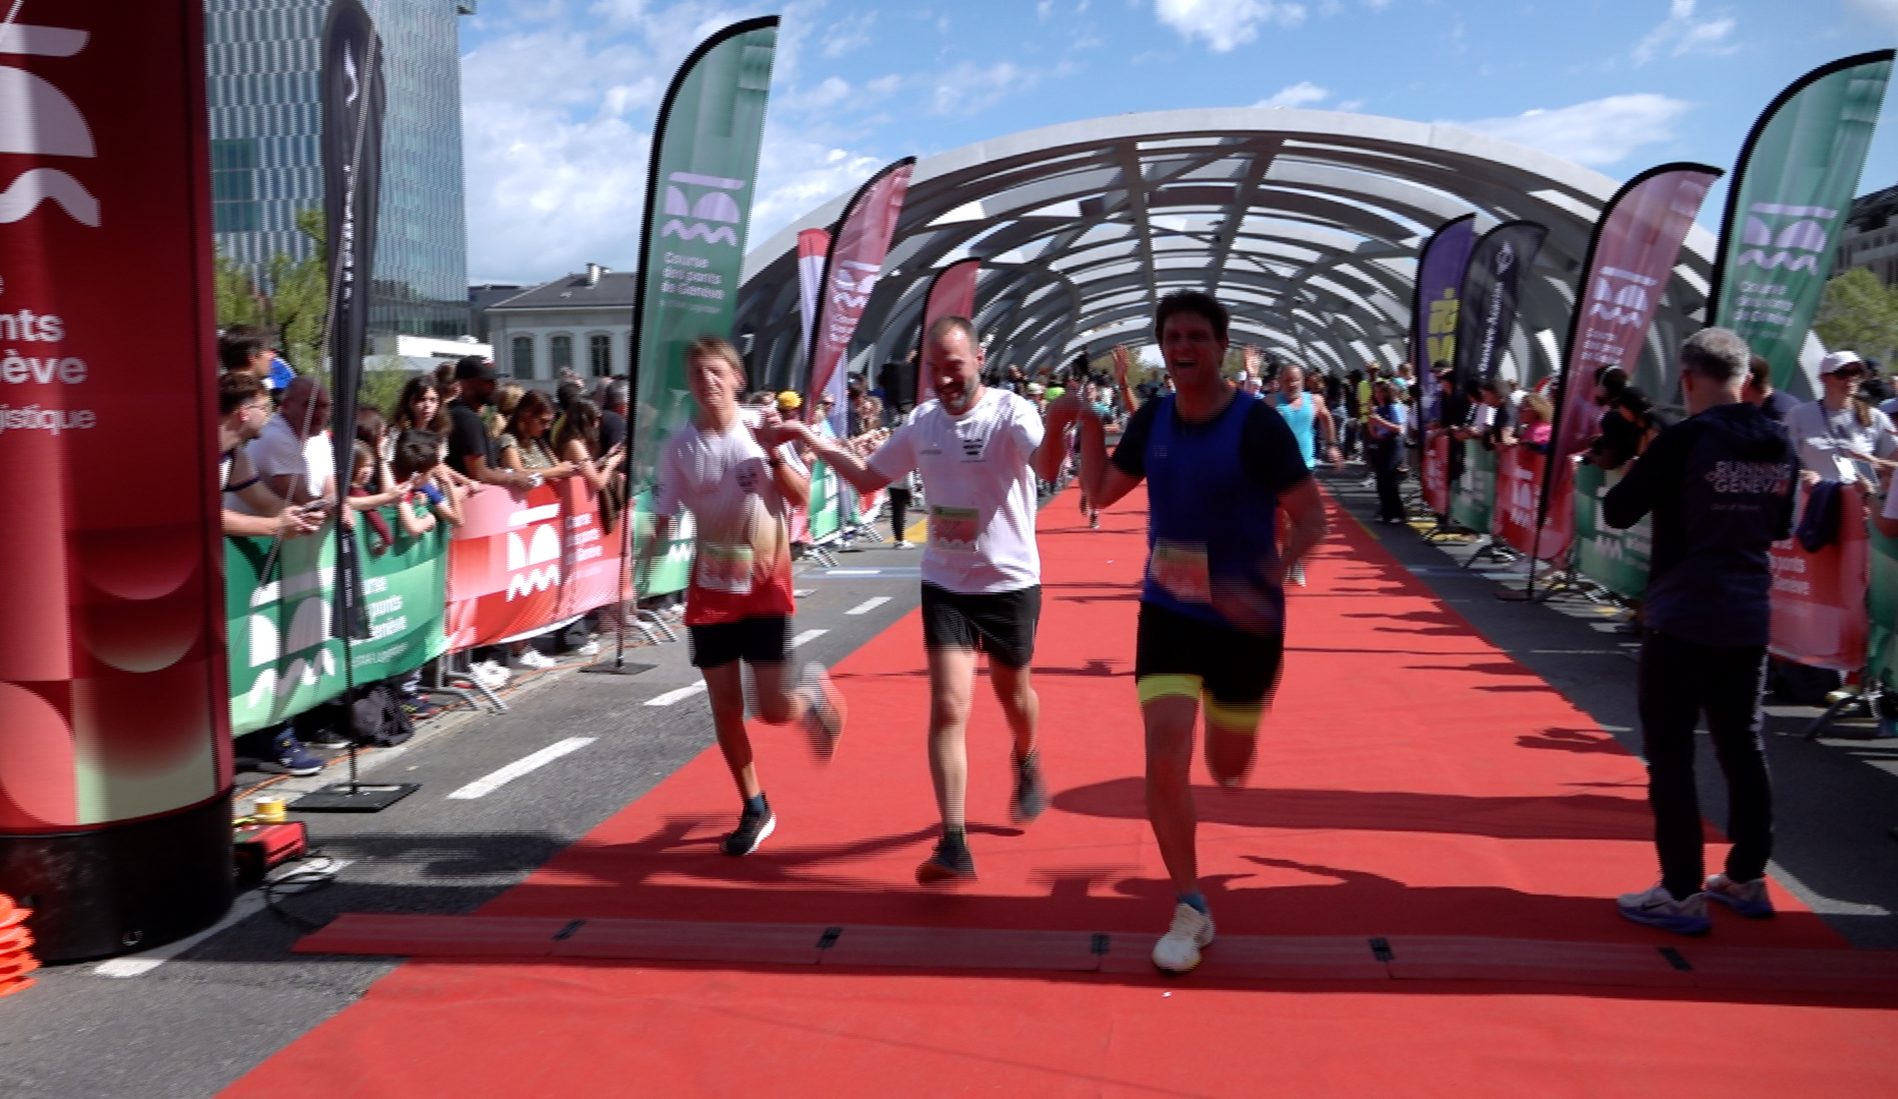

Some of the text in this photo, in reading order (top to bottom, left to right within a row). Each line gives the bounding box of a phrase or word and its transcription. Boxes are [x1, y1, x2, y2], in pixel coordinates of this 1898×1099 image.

[685, 271, 722, 285] ponts
[678, 283, 725, 299] Genève
[1714, 460, 1792, 480] RUNNING
[1713, 478, 1785, 495] GENEVA
